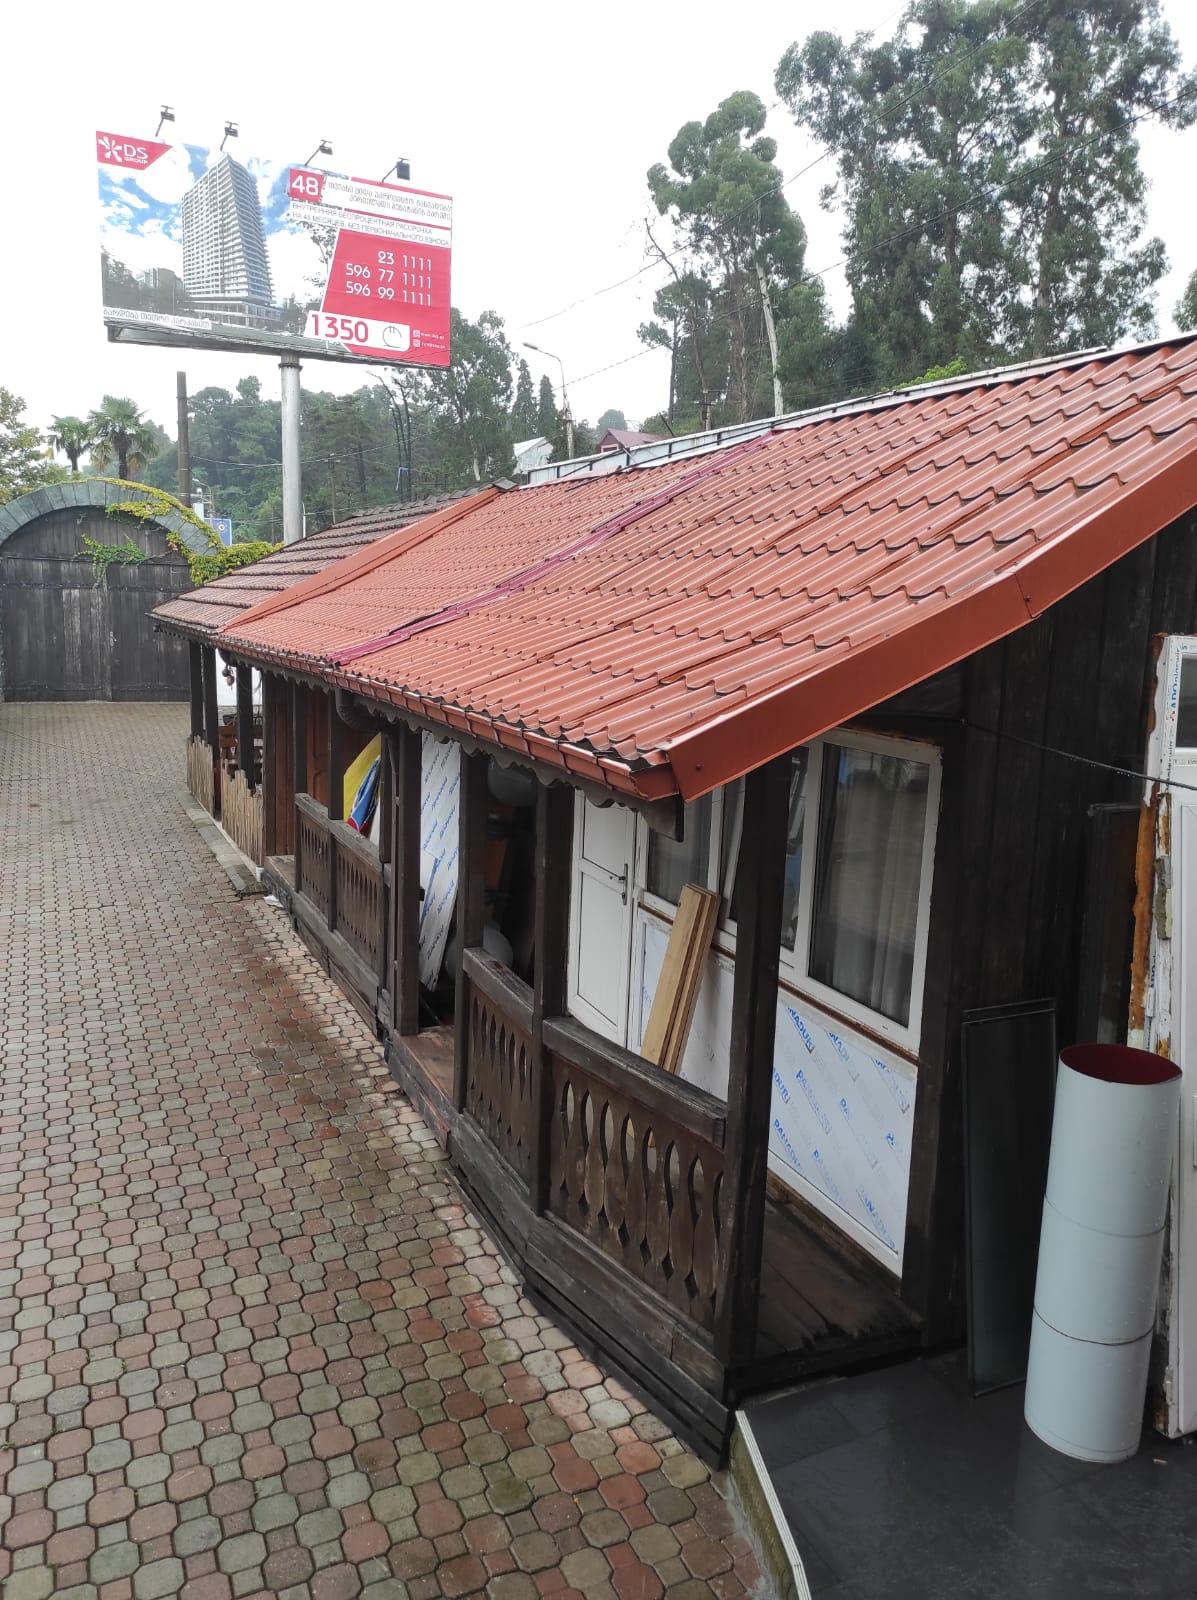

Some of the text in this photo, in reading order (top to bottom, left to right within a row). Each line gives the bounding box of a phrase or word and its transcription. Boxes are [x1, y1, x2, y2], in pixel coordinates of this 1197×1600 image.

[123, 144, 148, 160] DS
[291, 175, 319, 196] 48
[292, 202, 433, 235] ВНУТРЕННЯЯ БЕСПРОЦЕНТНАЯ РАССРОЧКА
[292, 211, 303, 220] НА
[347, 221, 361, 230] БЕЗ
[361, 223, 424, 243] ПЕРВОНАЧАЛЬНОГО
[423, 235, 449, 247] ВЗНОСА
[377, 251, 432, 271] 23 1111
[345, 263, 432, 289] 596 77 1111
[345, 281, 432, 307] 596 99 1111
